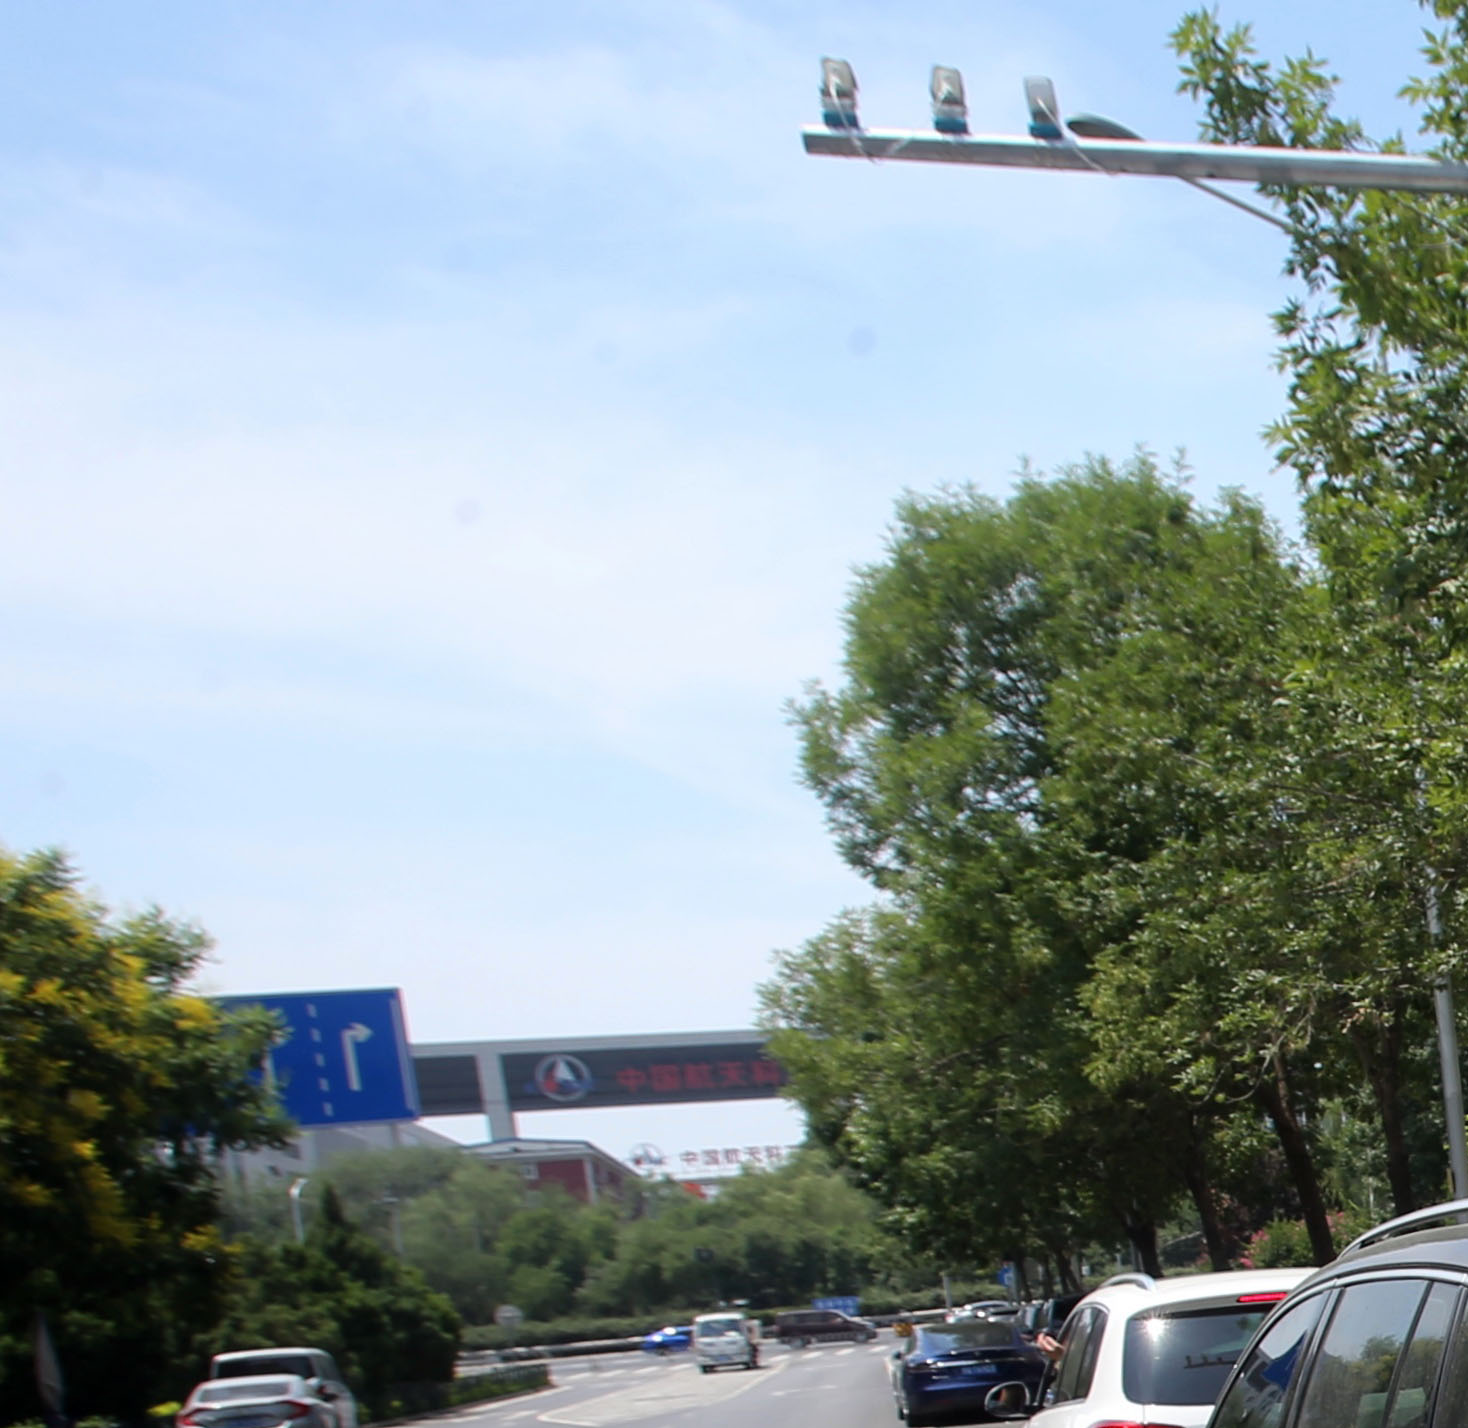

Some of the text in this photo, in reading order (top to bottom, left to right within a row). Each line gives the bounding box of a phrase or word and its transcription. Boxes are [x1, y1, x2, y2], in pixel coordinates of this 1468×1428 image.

[679, 1145, 800, 1165] 中国航天科
